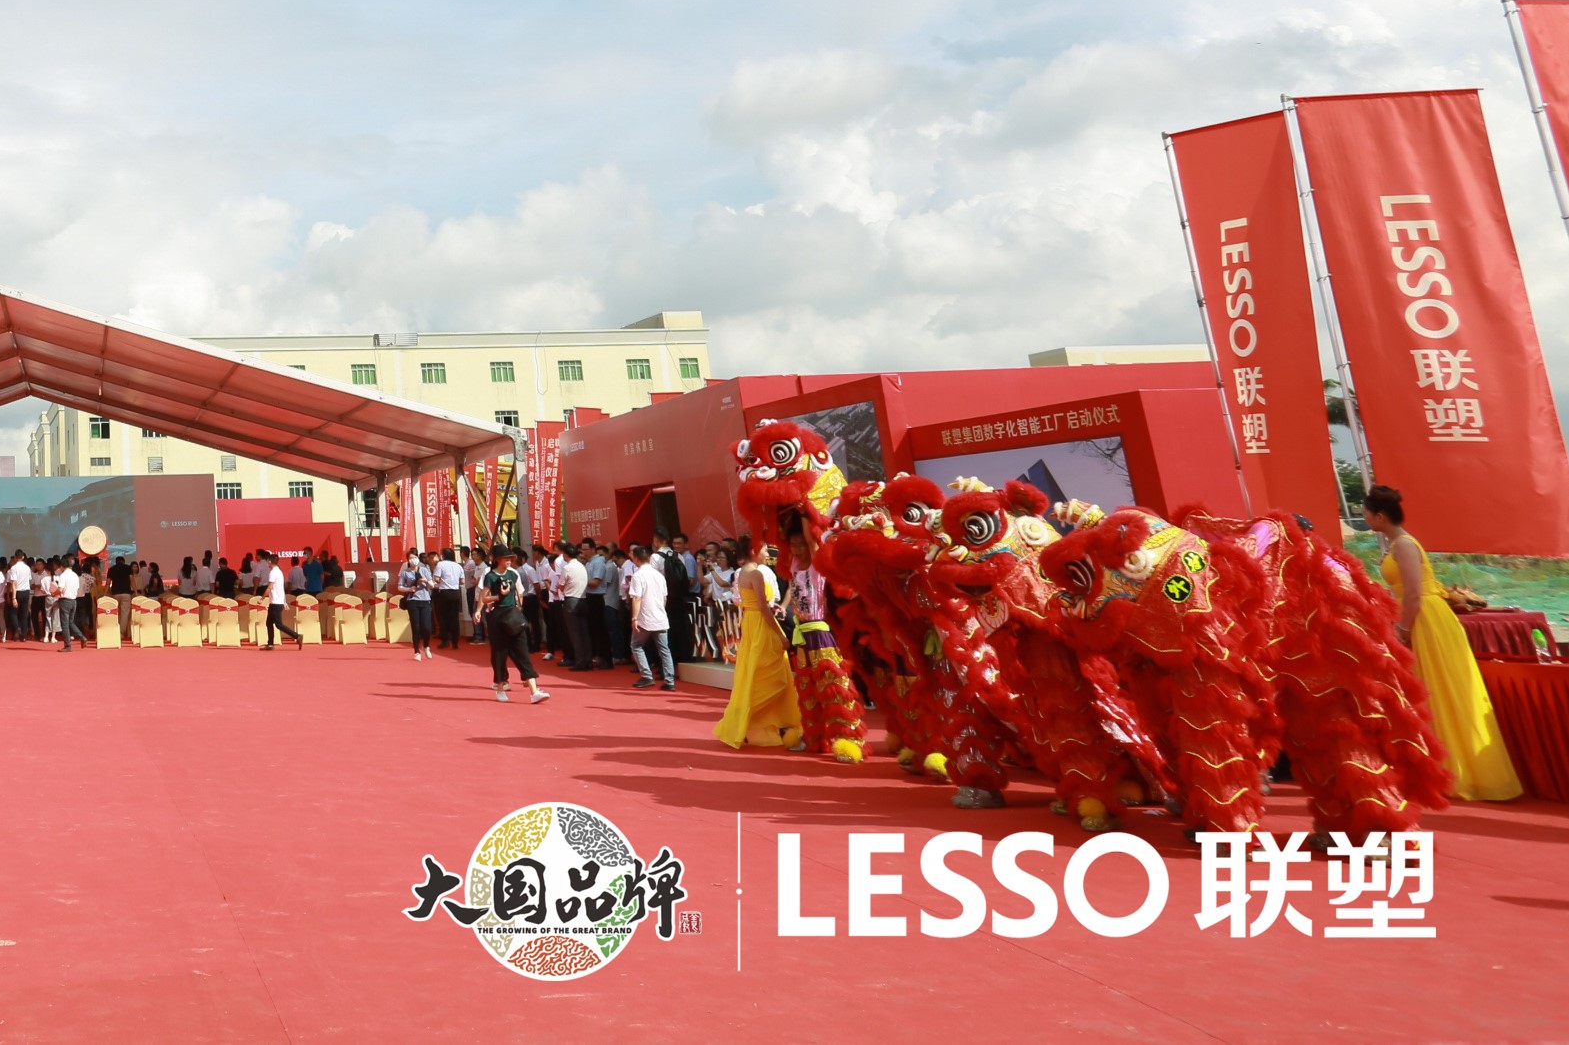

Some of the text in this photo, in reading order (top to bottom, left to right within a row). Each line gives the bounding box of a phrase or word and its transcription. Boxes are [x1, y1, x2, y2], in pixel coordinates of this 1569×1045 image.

[1219, 217, 1270, 454] LESSO 联塑
[1380, 193, 1489, 442] LESSO 联塑
[426, 481, 437, 516] LESSO
